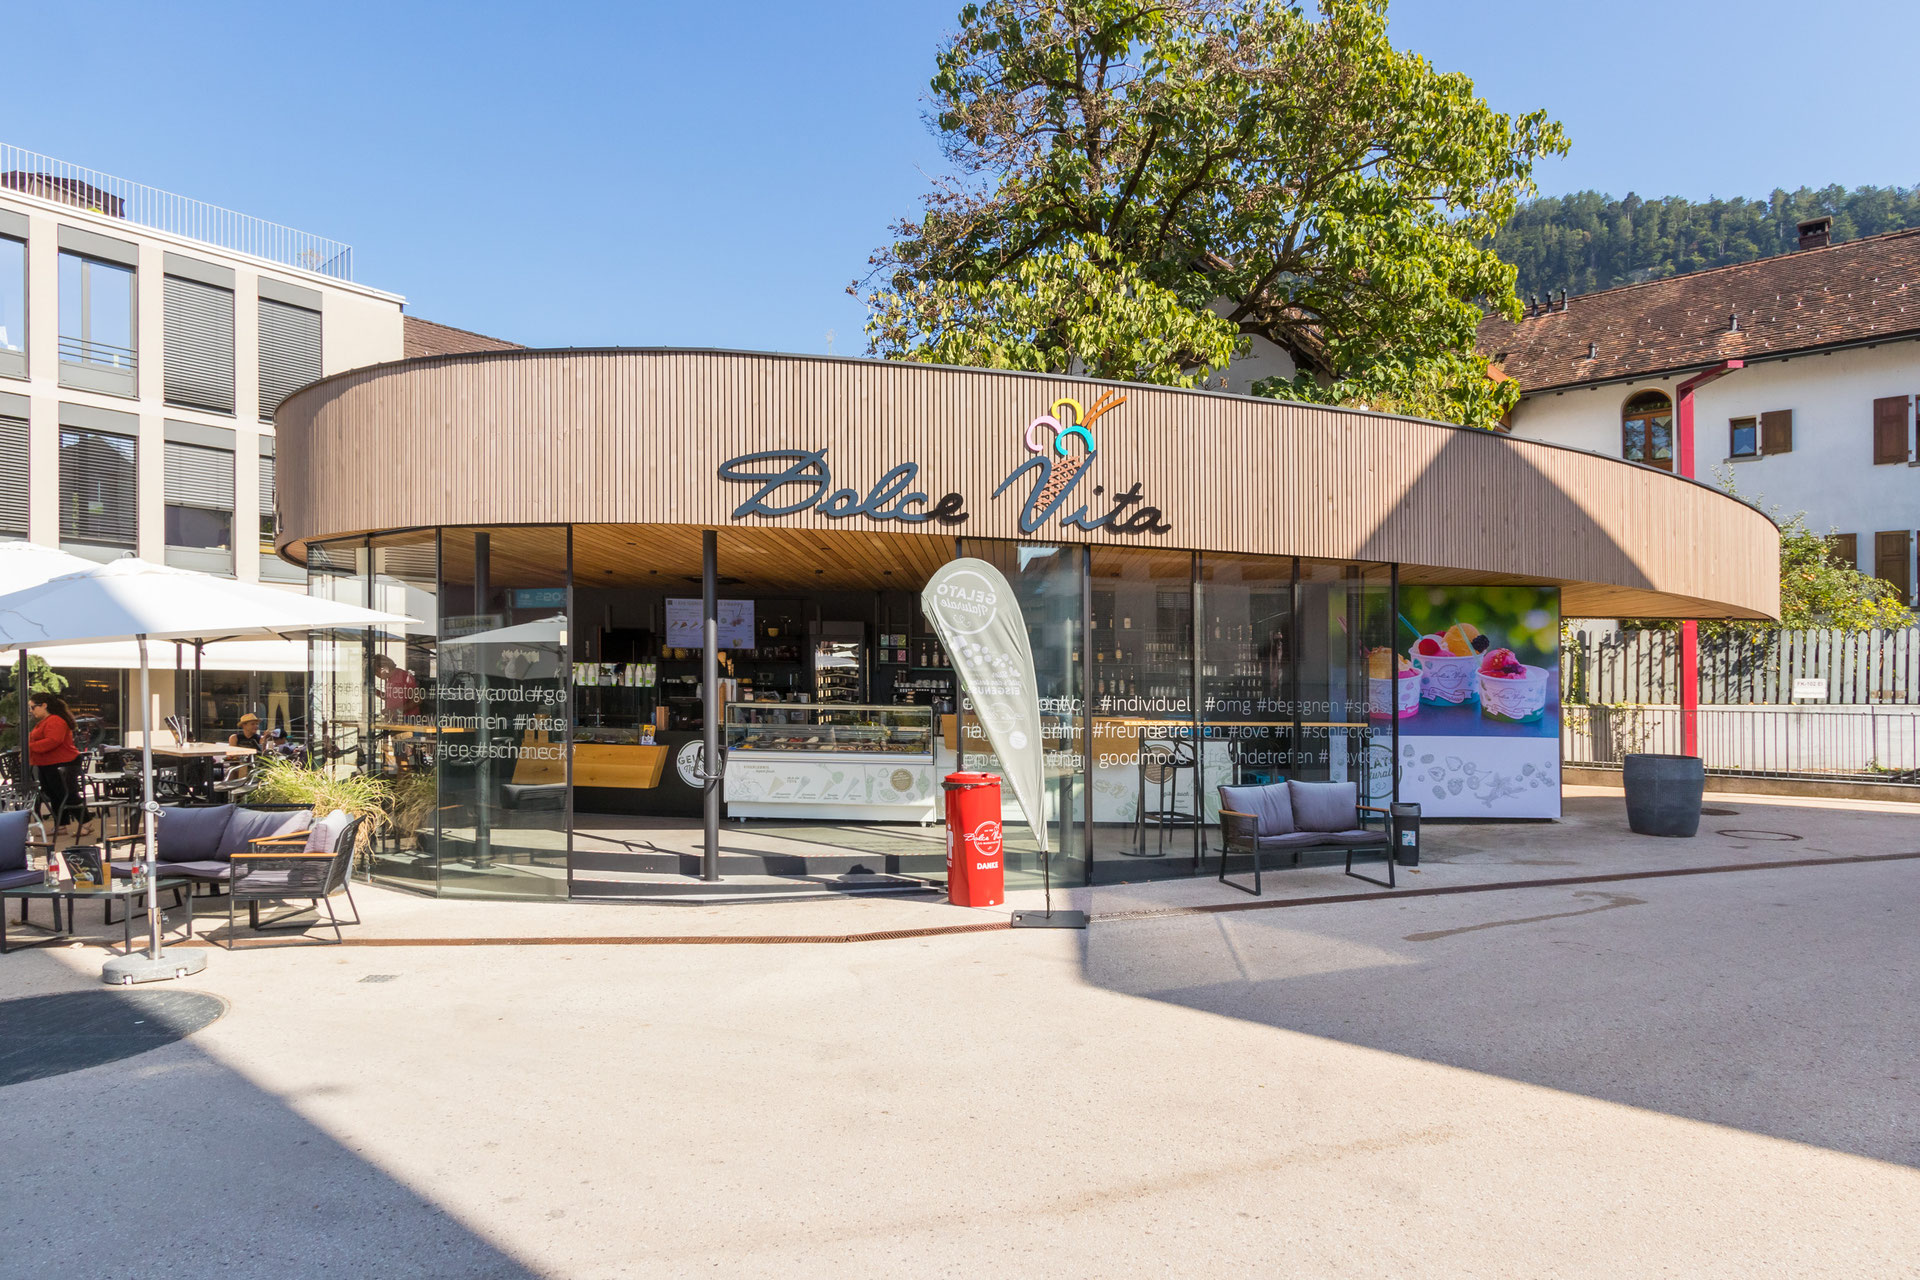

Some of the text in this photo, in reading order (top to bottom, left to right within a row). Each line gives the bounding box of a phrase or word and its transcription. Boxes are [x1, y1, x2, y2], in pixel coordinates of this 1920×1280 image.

[718, 447, 1172, 533] Dolce Vita
[1205, 696, 1251, 716] #omg
[1228, 723, 1269, 739] #love
[976, 861, 999, 870] DANKE
